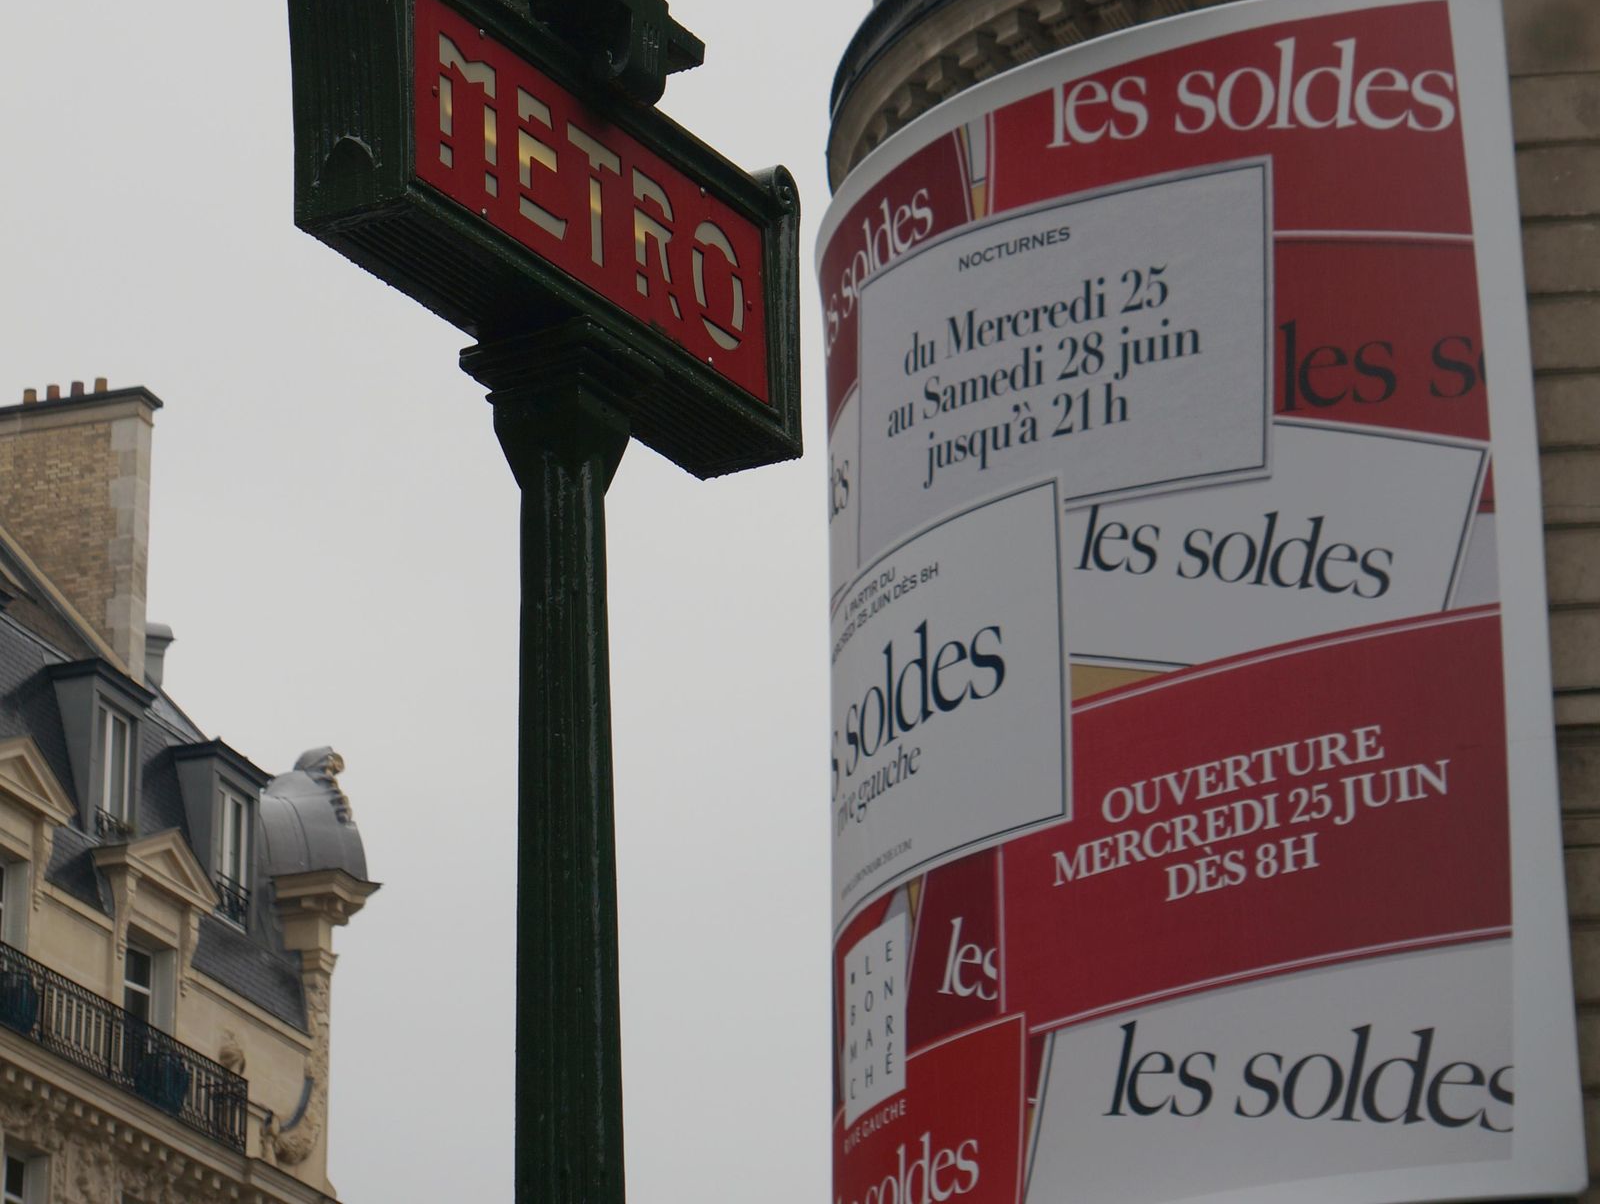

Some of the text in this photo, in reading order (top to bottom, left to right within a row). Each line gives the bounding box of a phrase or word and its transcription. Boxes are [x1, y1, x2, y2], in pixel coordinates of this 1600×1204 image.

[1046, 37, 1456, 149] les soldes
[438, 32, 745, 352] METRO
[841, 187, 933, 318] soldes
[958, 226, 1072, 272] NOCTURNES
[904, 262, 1169, 377] du Mercredi 25
[1274, 319, 1487, 413] les s
[887, 318, 1202, 438] au Samedi 28 juin
[923, 401, 1039, 489] jusqu'à
[880, 566, 896, 588] DU
[893, 575, 918, 600] DÈS
[920, 561, 939, 584] 8H
[1073, 503, 1394, 599] les soldes
[845, 618, 1006, 777] soldes
[856, 744, 921, 824] gauche
[1101, 725, 1386, 824] OUVERTURE
[1052, 760, 1451, 887] MERCREDI 25 JUIN
[1164, 832, 1320, 903] DÈS 8H
[937, 916, 998, 1001] les
[862, 1098, 907, 1139] GAUCHE
[1102, 1019, 1515, 1133] les soldes
